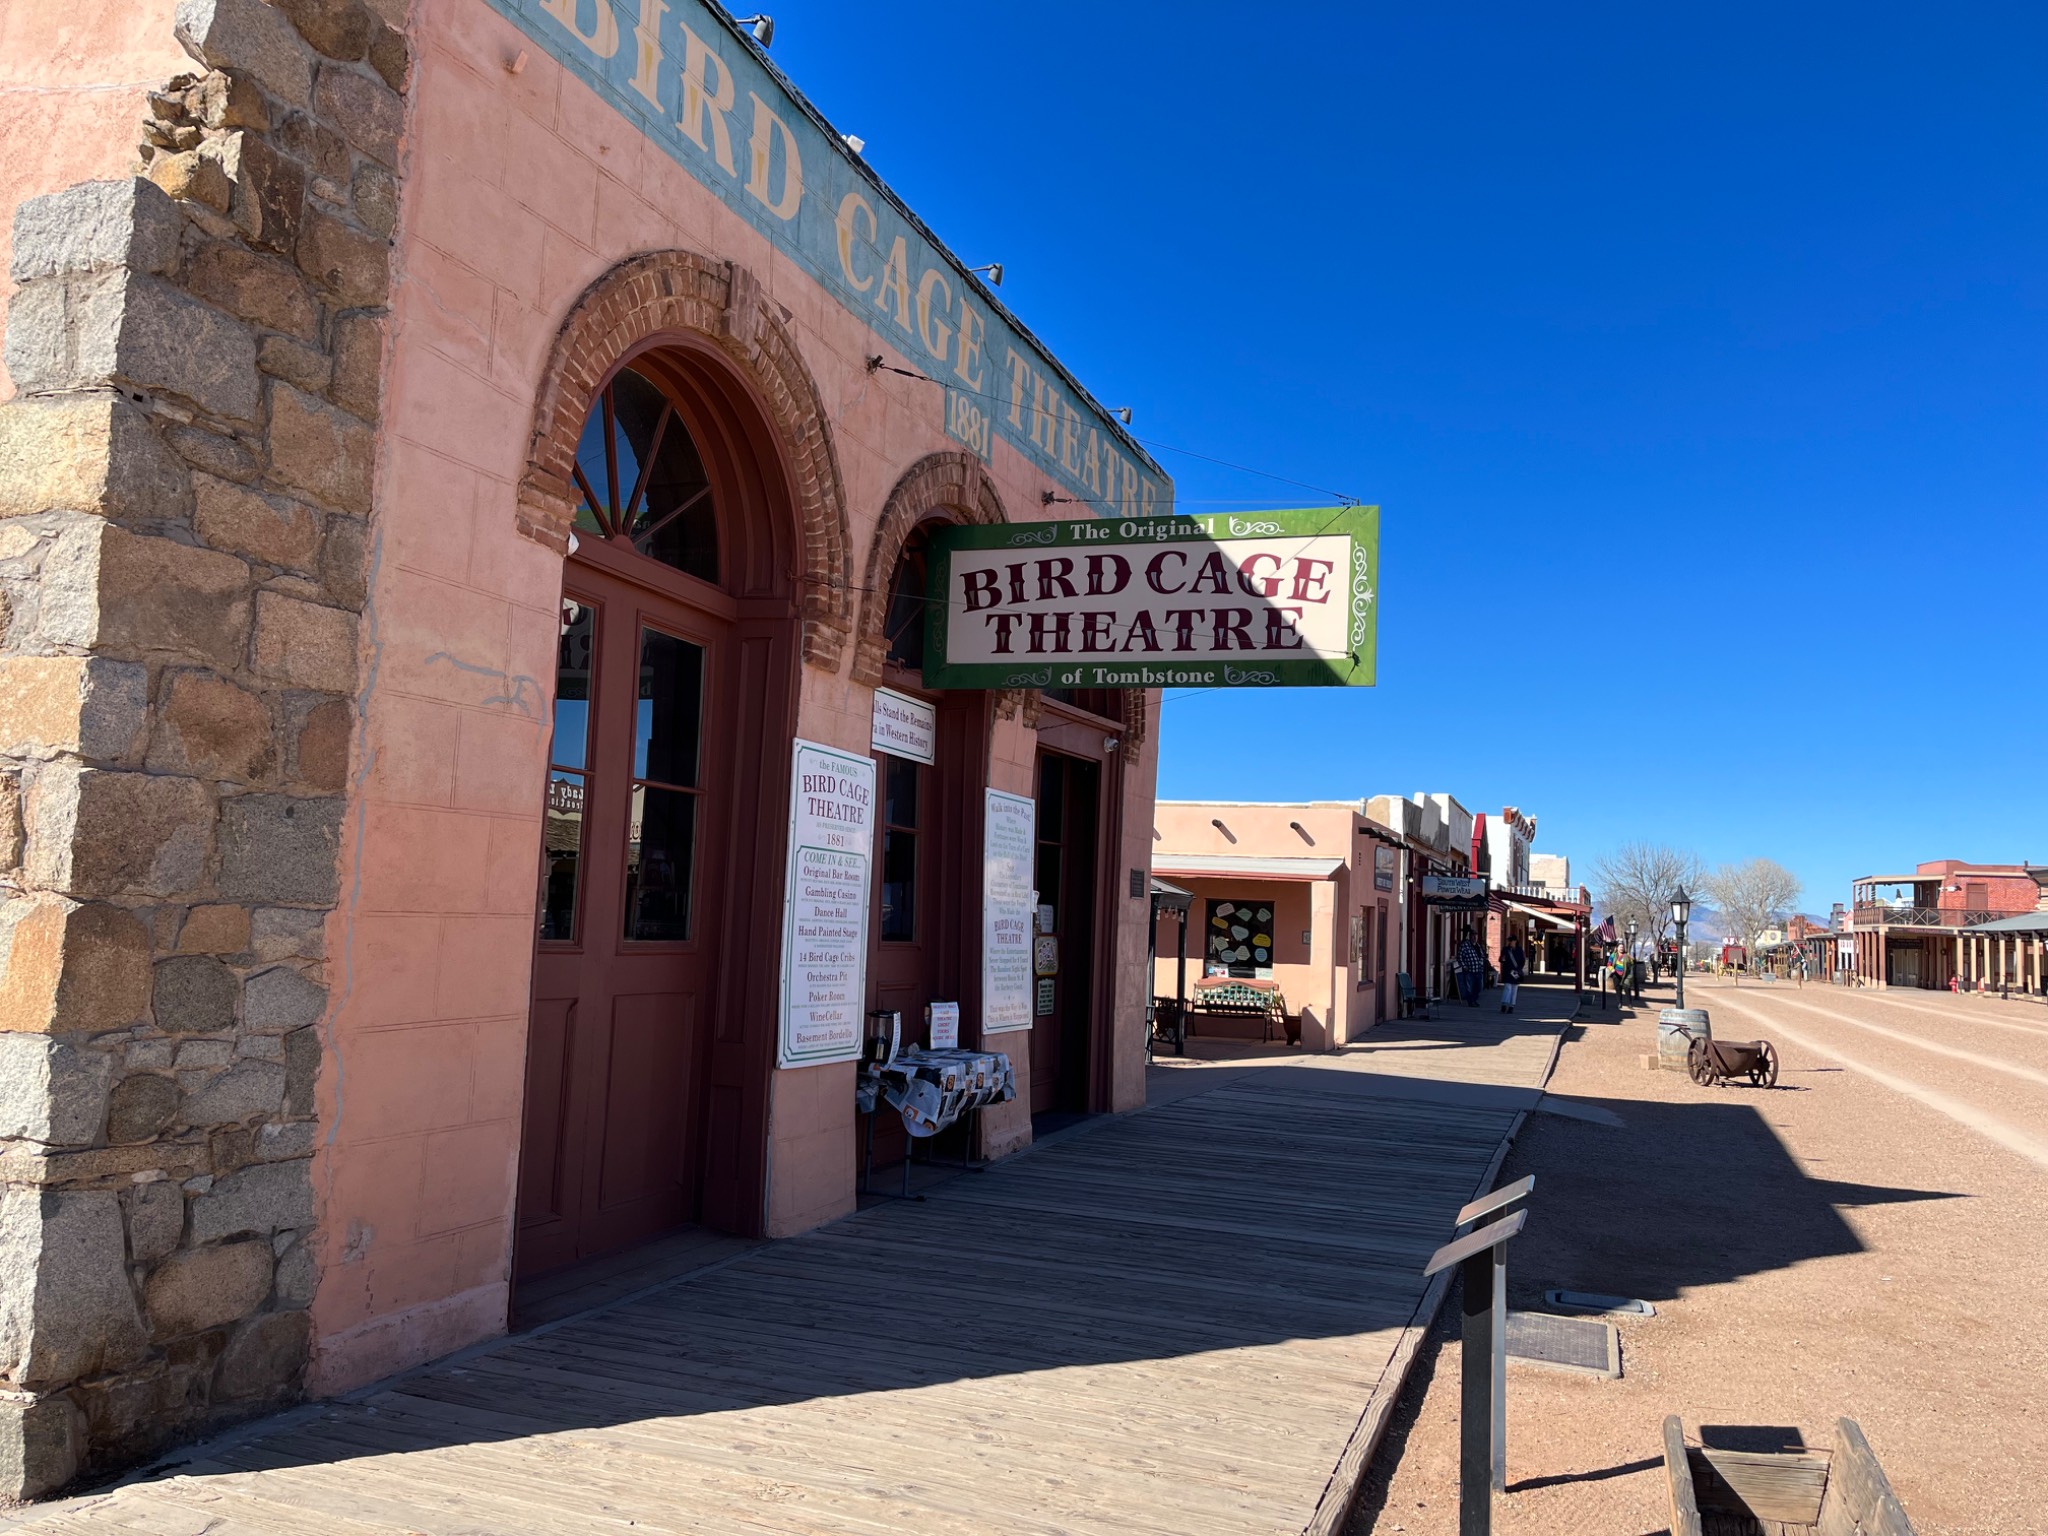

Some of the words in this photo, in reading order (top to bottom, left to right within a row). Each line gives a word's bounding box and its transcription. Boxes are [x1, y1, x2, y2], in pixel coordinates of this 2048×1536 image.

[834, 192, 984, 392] CAGE
[1003, 345, 1157, 517] THEATRE
[947, 390, 992, 457] 1881
[1070, 524, 1110, 541] The
[1119, 519, 1215, 542] Original
[959, 554, 1132, 614] BIRD
[1145, 550, 1334, 605] CAGE
[985, 607, 1304, 654] THEATRE
[1060, 667, 1083, 685] of
[1093, 666, 1215, 684] Tombstone
[882, 702, 899, 721] Stand
[900, 709, 909, 724] the
[885, 724, 908, 742] Western
[819, 759, 830, 770] the
[831, 762, 858, 778] FAMOUS
[802, 775, 836, 793] BIRD
[839, 778, 869, 806] CAGE
[808, 797, 864, 824] THEATRE
[827, 833, 844, 847] 1881
[804, 851, 828, 865] COME
[828, 854, 836, 866] IN
[838, 856, 843, 867] &
[804, 865, 831, 879] Original
[832, 869, 842, 879] Bar
[844, 871, 860, 881] Room
[805, 886, 836, 900] Gambling
[838, 889, 856, 899] Casino
[814, 906, 834, 918] Dance
[835, 908, 847, 918] Hall
[798, 925, 816, 936] Hand
[818, 926, 841, 938] Painted
[843, 927, 858, 939] Stage
[994, 919, 1009, 932] BIRD
[1009, 919, 1025, 933] CAGE
[996, 933, 1023, 944] THEATRE
[799, 953, 807, 962] 14
[809, 952, 823, 962] Bird
[824, 953, 839, 964] Cage
[840, 952, 855, 962] Cribs
[807, 971, 837, 982] Orchestra
[839, 971, 848, 981] Pit
[809, 991, 827, 1002] Poker
[829, 991, 845, 1001] Room
[797, 1033, 828, 1044] Basement
[829, 1029, 853, 1040] Bordello
